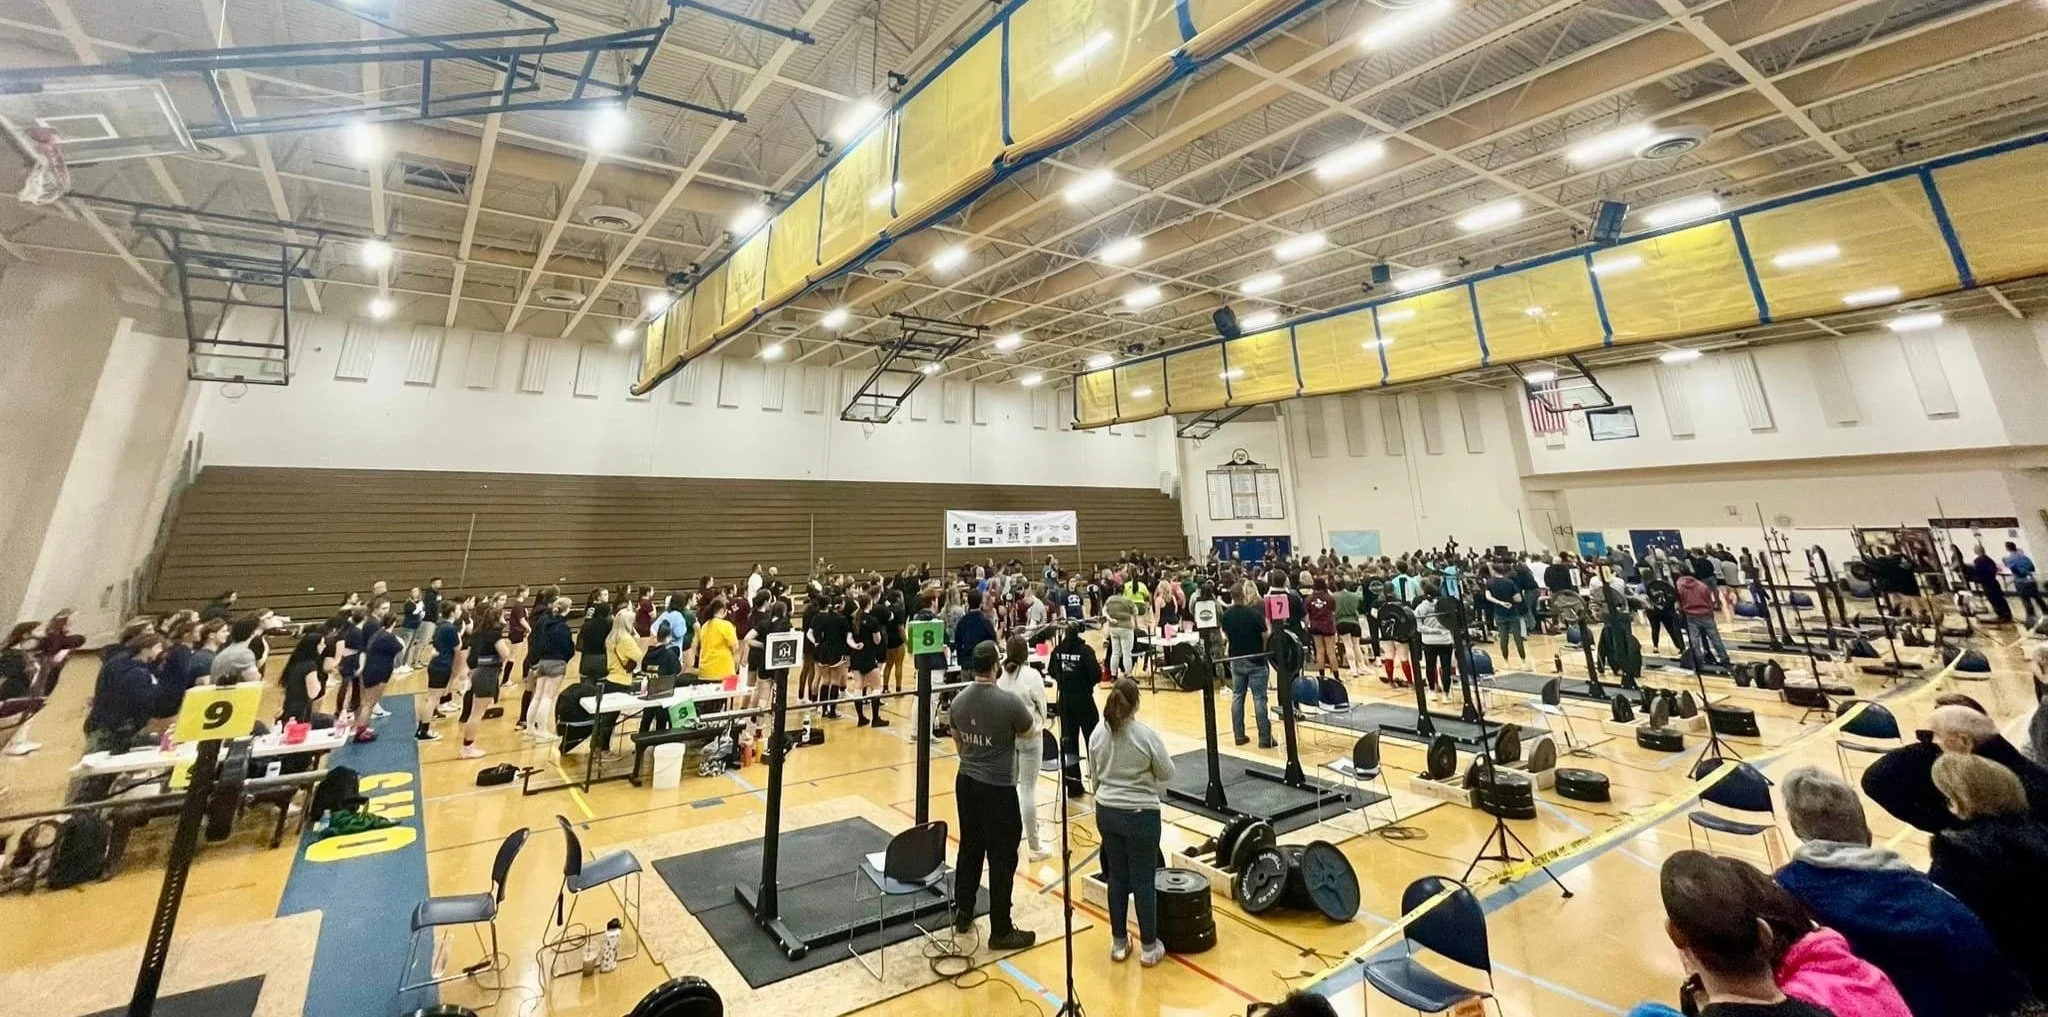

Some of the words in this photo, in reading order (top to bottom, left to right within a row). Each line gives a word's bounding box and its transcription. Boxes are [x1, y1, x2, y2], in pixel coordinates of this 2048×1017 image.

[1276, 601, 1284, 614] 7
[922, 629, 935, 647] 8
[202, 700, 234, 730] 9
